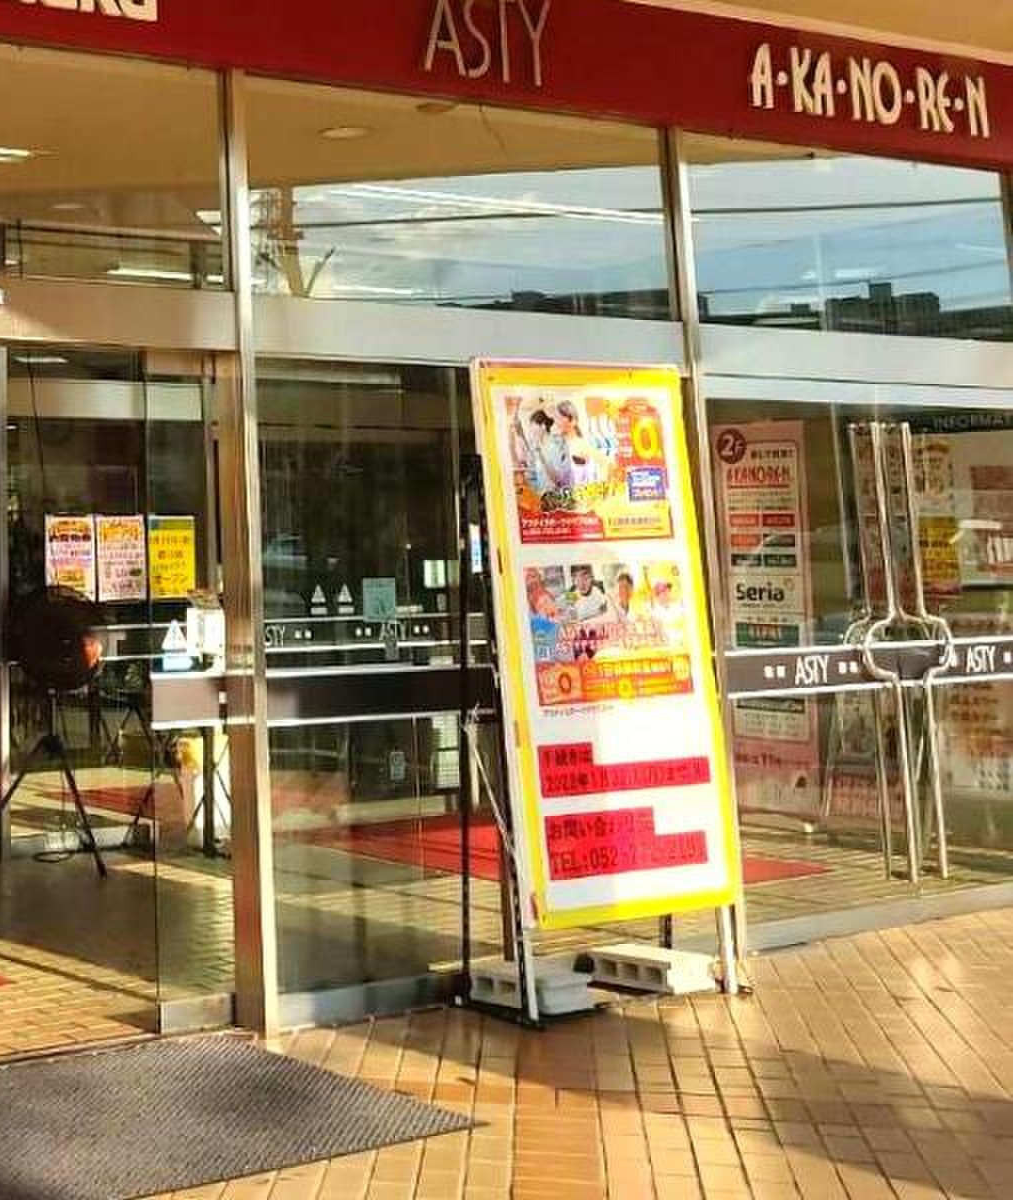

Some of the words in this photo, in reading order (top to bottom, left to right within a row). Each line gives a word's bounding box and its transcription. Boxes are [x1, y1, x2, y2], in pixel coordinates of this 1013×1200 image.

[736, 582, 785, 601] Seria
[795, 655, 830, 685] ASTY
[966, 645, 996, 673] ASTY
